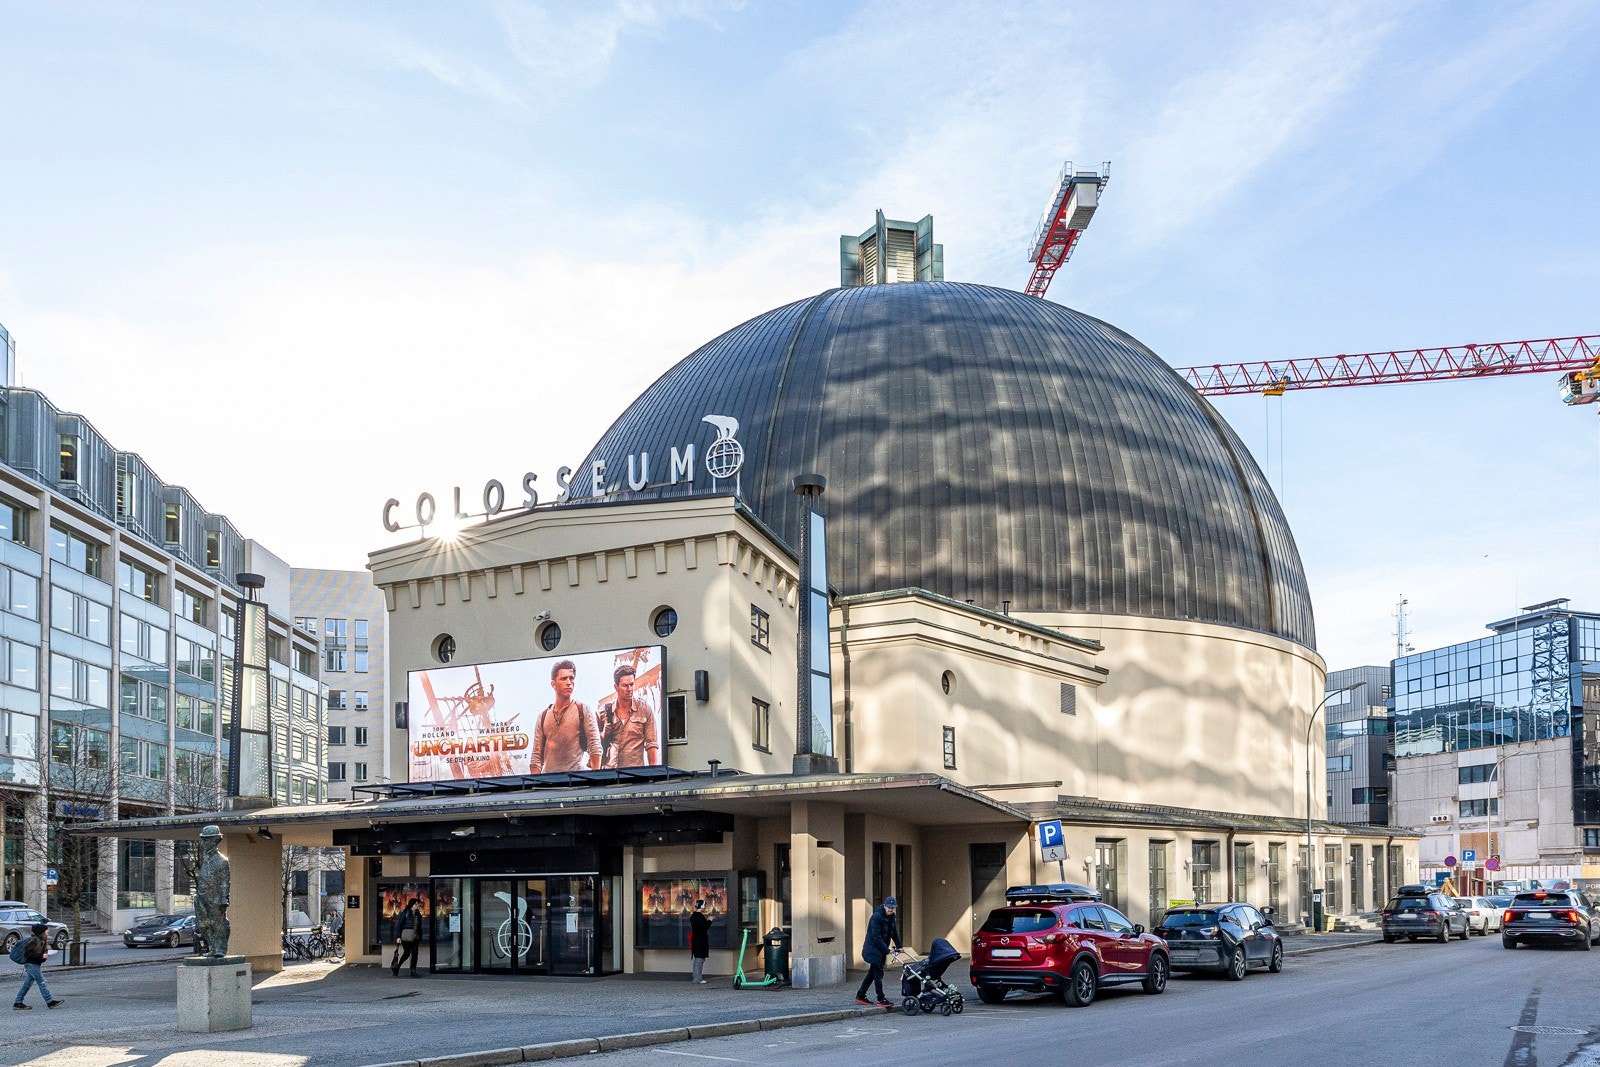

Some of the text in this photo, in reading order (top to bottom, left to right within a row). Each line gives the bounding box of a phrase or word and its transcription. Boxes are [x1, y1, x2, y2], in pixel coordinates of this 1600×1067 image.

[383, 443, 695, 533] COLOSSEUM
[422, 731, 455, 739] HOLLAND
[479, 726, 520, 735] WAHLBERG
[413, 733, 529, 757] UNCHARTED
[1044, 825, 1056, 845] P
[1465, 851, 1473, 860] P
